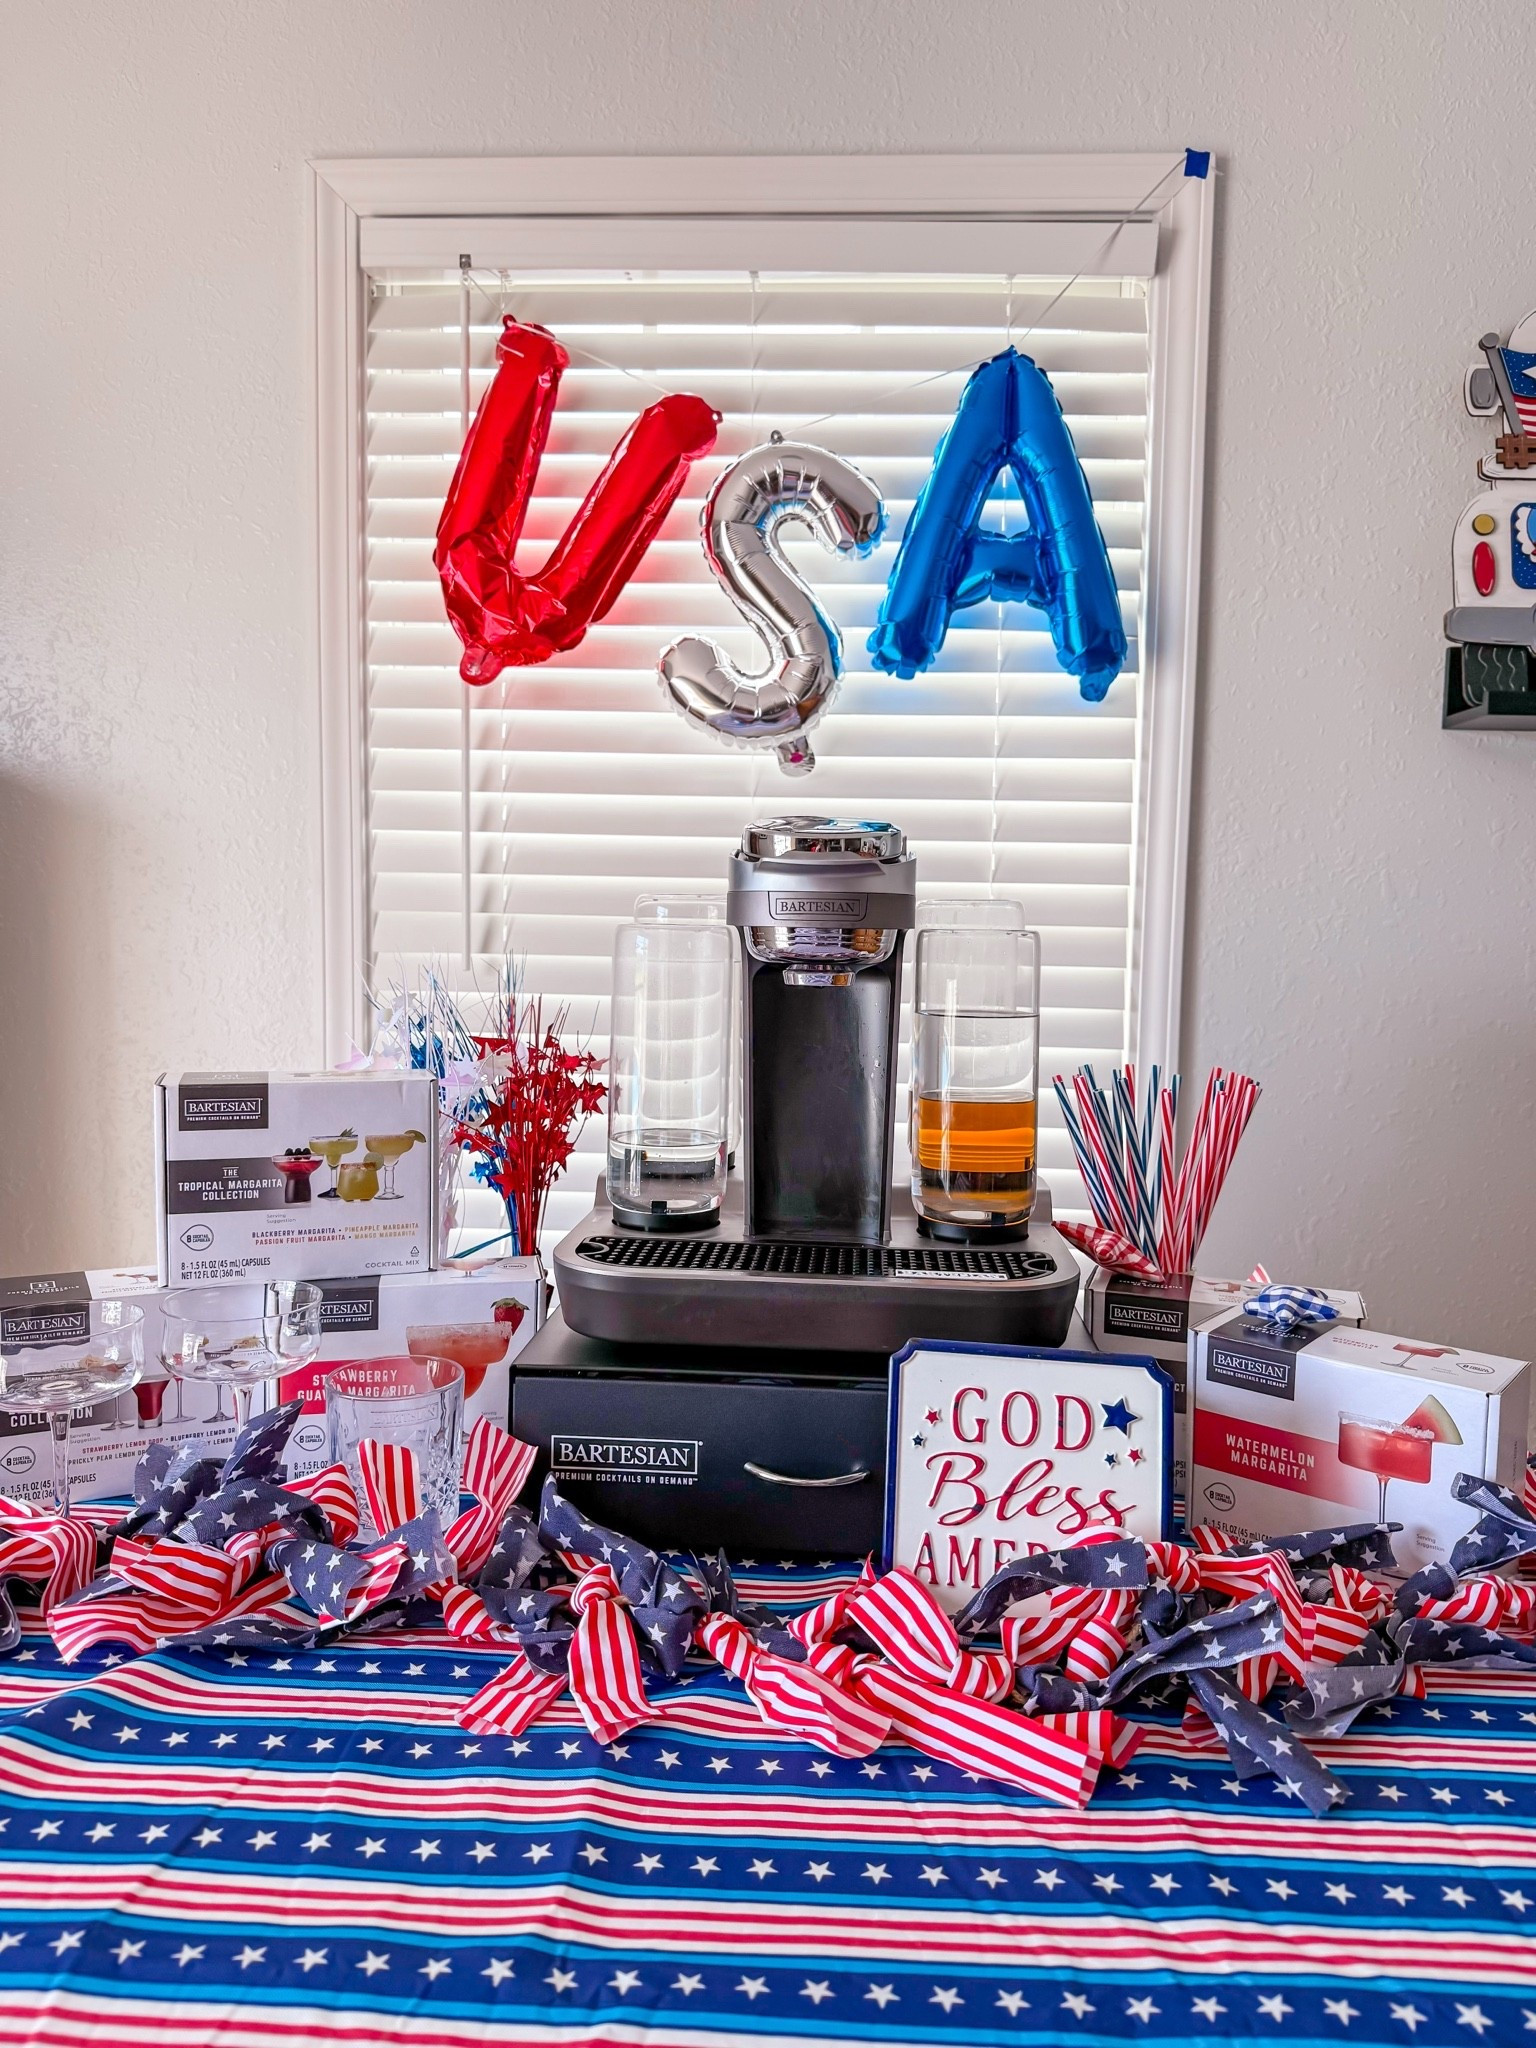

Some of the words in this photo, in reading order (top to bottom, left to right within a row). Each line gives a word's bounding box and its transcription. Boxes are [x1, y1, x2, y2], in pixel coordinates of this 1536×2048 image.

[780, 901, 856, 912] BARTESIAN
[188, 1101, 257, 1112] BARTESIAN
[178, 1181, 224, 1192] TROPICAL
[228, 1178, 283, 1190] MARGARITA
[202, 1190, 260, 1201] COLLECTION
[187, 1235, 191, 1243] 8
[252, 1230, 295, 1238] BLACKBERRY
[181, 1262, 185, 1270] 8
[190, 1261, 200, 1270] 1.5
[201, 1261, 208, 1269] FL
[218, 1260, 228, 1269] (45
[241, 1257, 271, 1267] CAPSULES
[181, 1272, 192, 1280] NET
[194, 1271, 201, 1279] 12
[202, 1271, 210, 1279] FL
[210, 1270, 218, 1278] OZ
[219, 1269, 233, 1279] (360
[320, 1303, 367, 1315] RTESIAN
[1114, 1308, 1177, 1324] BARTESIAN
[7, 1316, 82, 1333] BARTESIAN
[1217, 1353, 1284, 1378] BARTESIAN
[348, 1384, 416, 1397] MARGARITA
[951, 1386, 1094, 1451] GOD
[82, 1443, 123, 1454] STRAWBERRY
[126, 1439, 146, 1448] LEMON
[206, 1428, 226, 1437] LEMON
[213, 1437, 233, 1445] LEMON
[559, 1443, 690, 1467] BARTESIAN
[1226, 1433, 1315, 1468] WATERMELON
[6, 1458, 12, 1466] 8
[68, 1456, 94, 1465] PRICKLY
[115, 1451, 135, 1459] LEMON
[303, 1461, 312, 1470] 1.5
[313, 1461, 320, 1469] FL
[320, 1460, 328, 1468] OZ
[1231, 1450, 1307, 1481] MARGARITA
[555, 1472, 592, 1481] PREMIUM
[596, 1474, 642, 1483] COCKTAILS
[1, 1487, 5, 1495] 8
[11, 1484, 20, 1493] 1.5
[22, 1483, 30, 1492] FL
[31, 1482, 39, 1490] OZ
[40, 1480, 51, 1490] (45
[925, 1451, 1138, 1535] Bless
[33, 1492, 40, 1500] OZ
[1209, 1491, 1214, 1499] 8
[1212, 1520, 1221, 1530] 1.5
[1222, 1522, 1228, 1532] FL
[1229, 1525, 1237, 1534] OZ
[1238, 1526, 1248, 1537] (45
[1416, 1534, 1436, 1544] Serving
[1416, 1540, 1445, 1552] Suggestion
